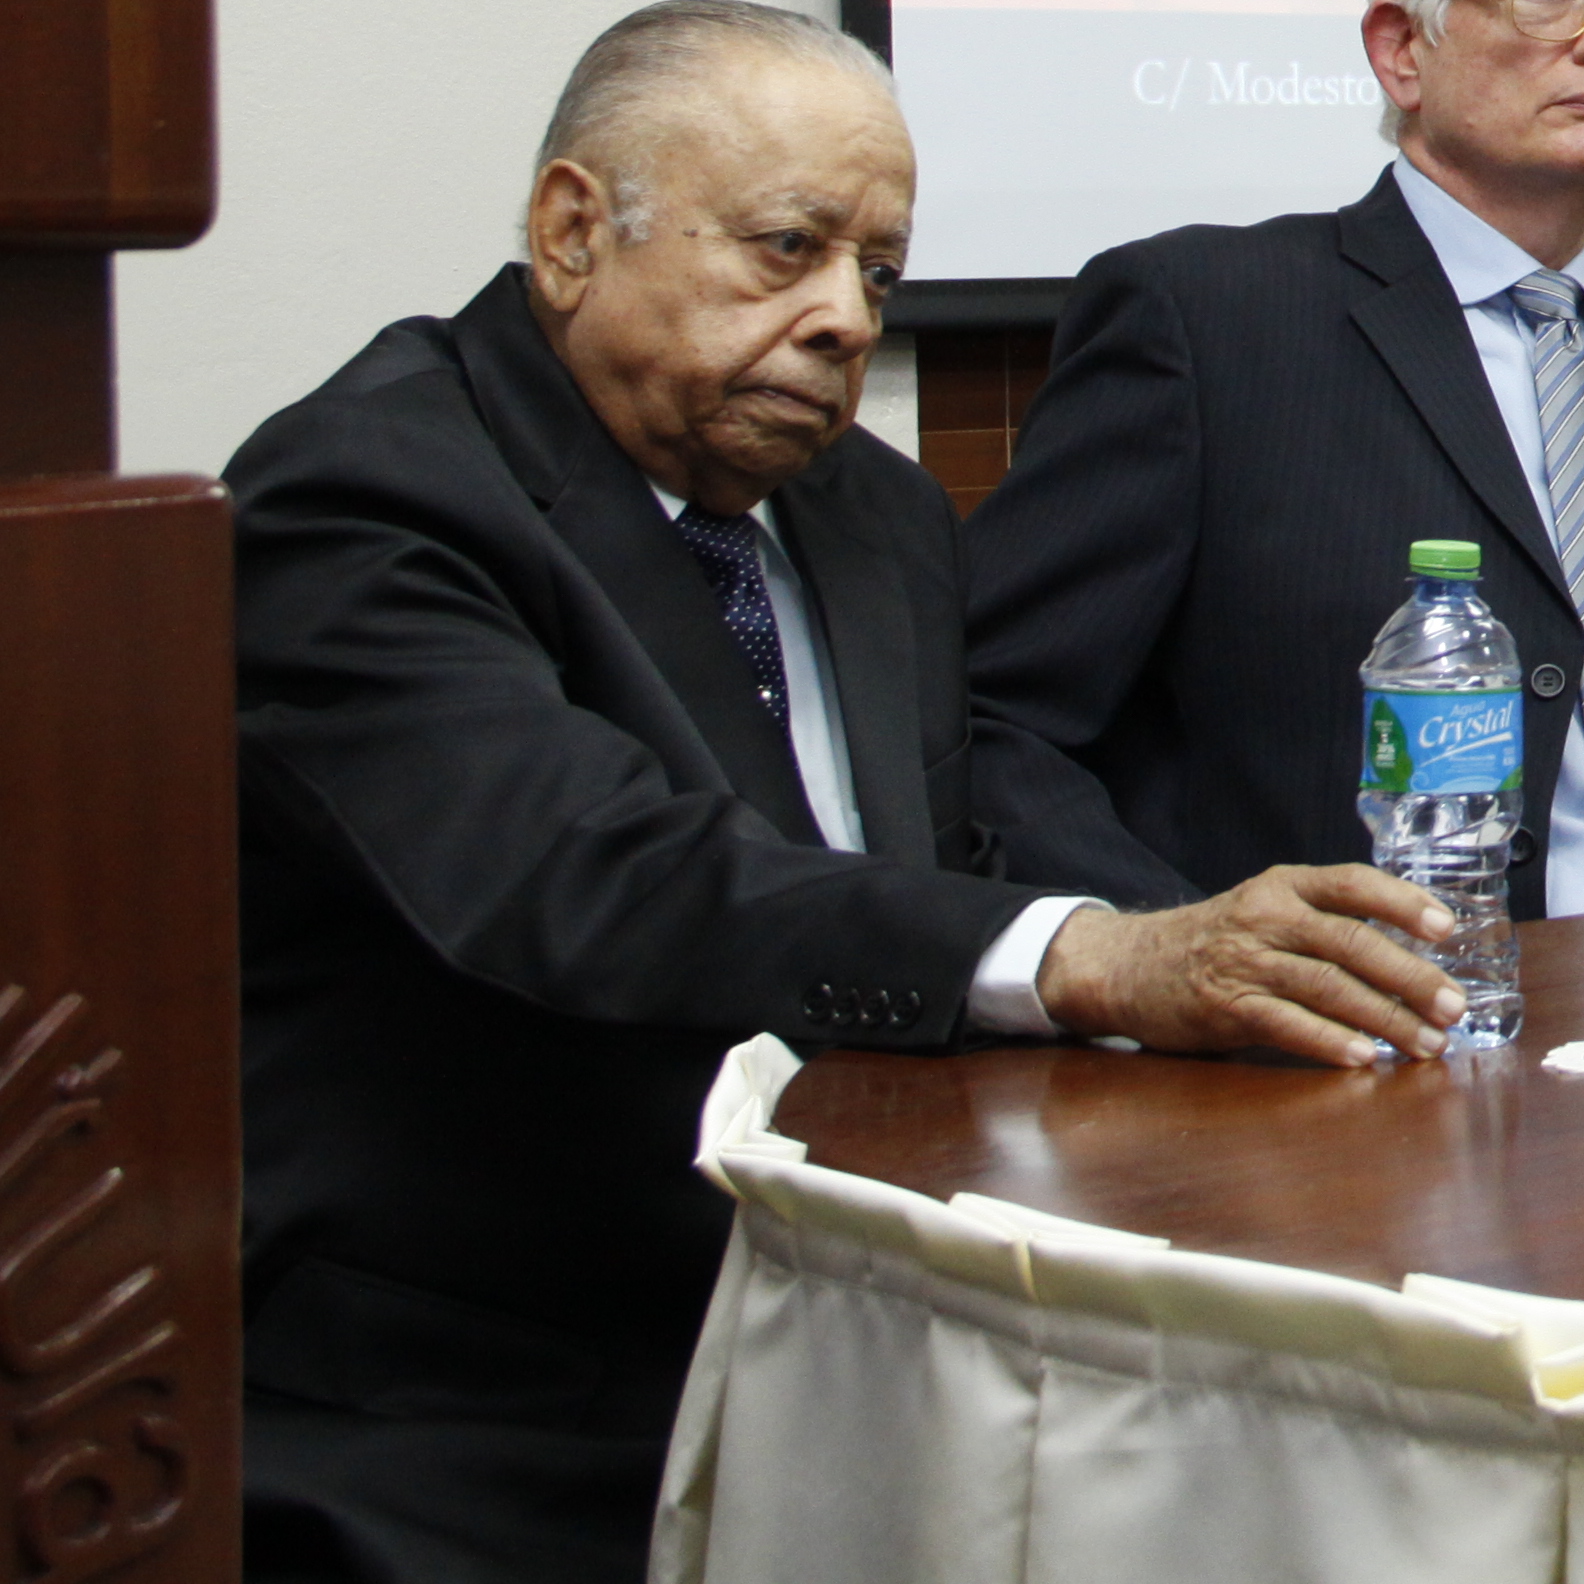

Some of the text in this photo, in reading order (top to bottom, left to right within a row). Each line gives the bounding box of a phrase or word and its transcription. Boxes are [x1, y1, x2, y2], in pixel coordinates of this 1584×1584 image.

[1133, 57, 1380, 112] C/ Modesto
[1418, 700, 1514, 752] Crystal
